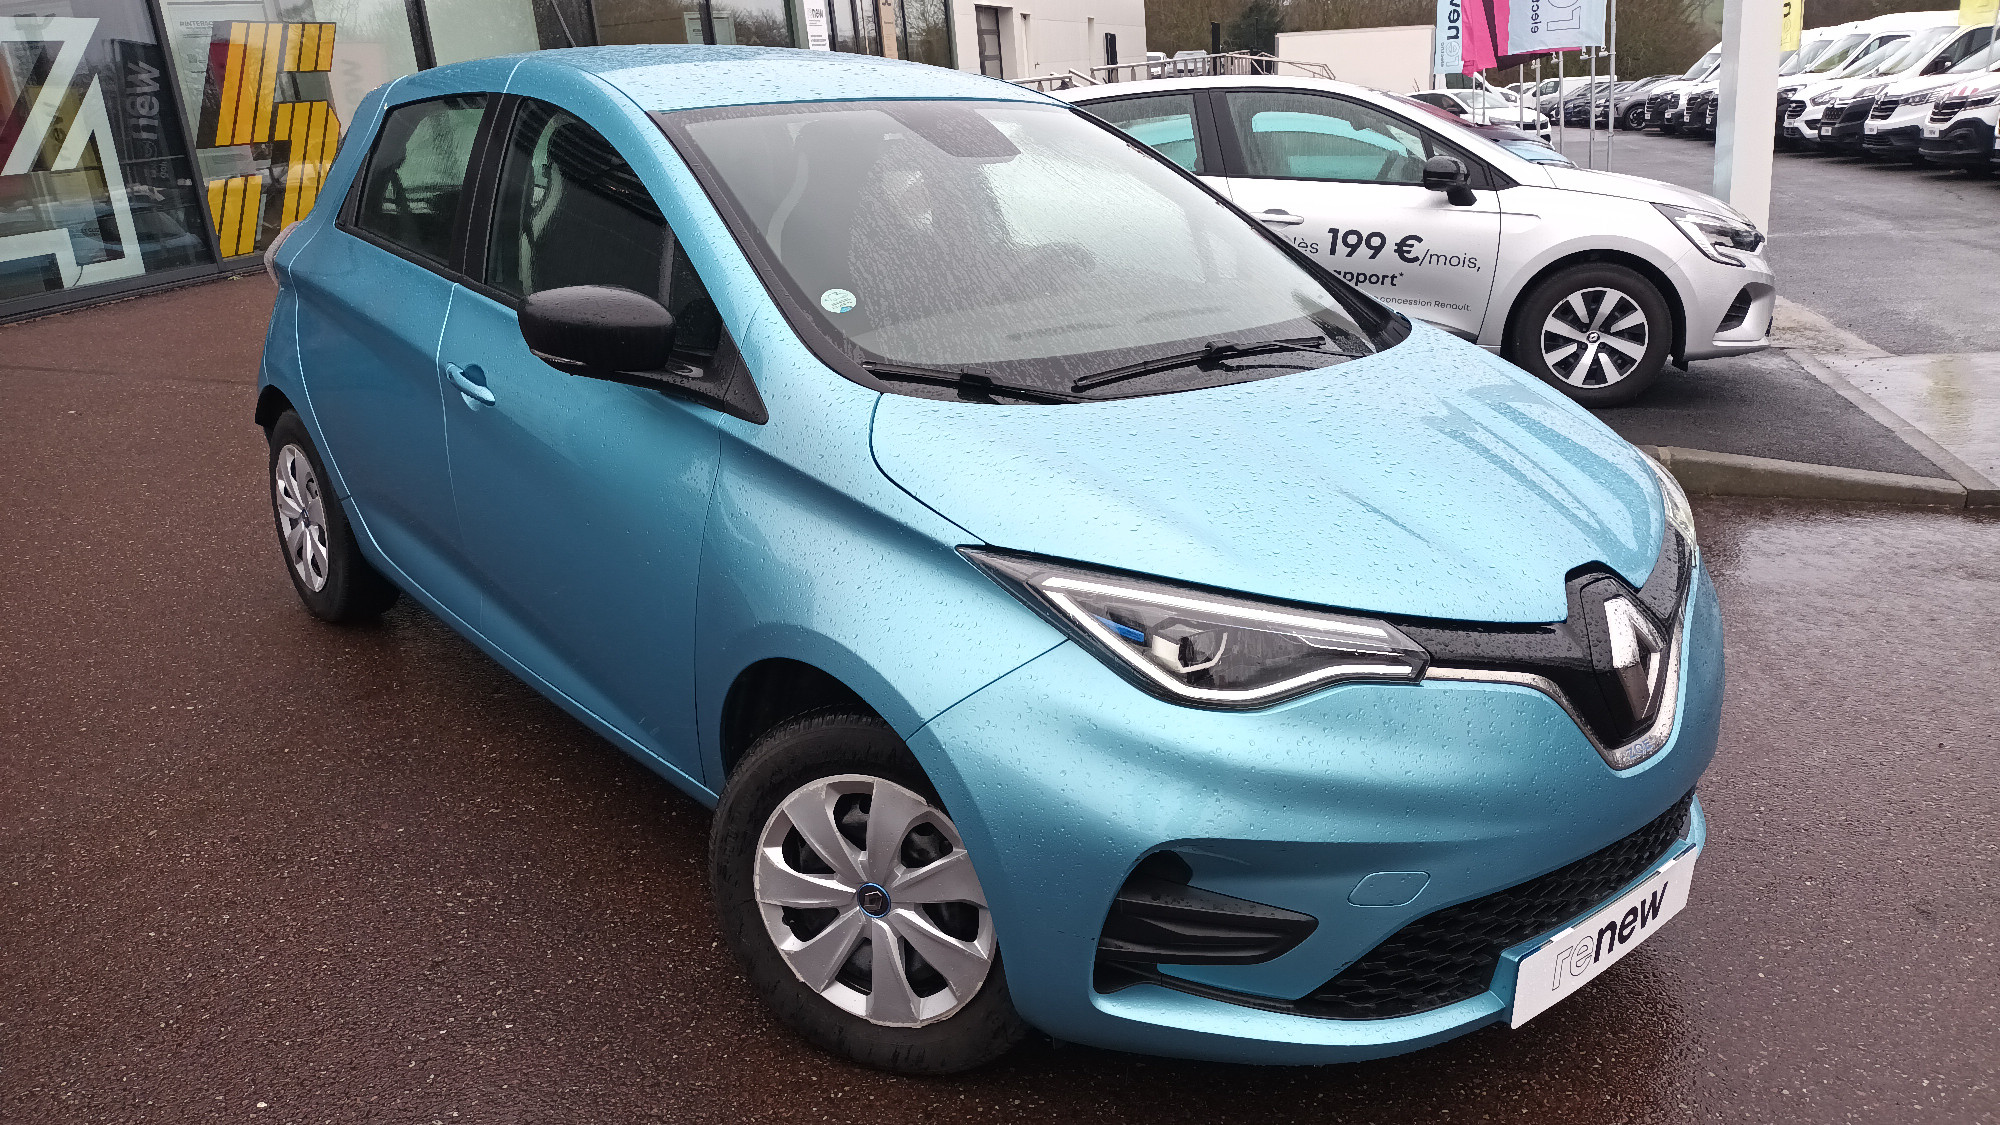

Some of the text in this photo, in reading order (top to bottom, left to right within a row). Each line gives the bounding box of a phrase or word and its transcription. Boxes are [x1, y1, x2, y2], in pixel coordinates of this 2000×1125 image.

[1327, 227, 1387, 260] 199
[1380, 296, 1472, 312] concession Renault.
[1551, 880, 1669, 992] renew
